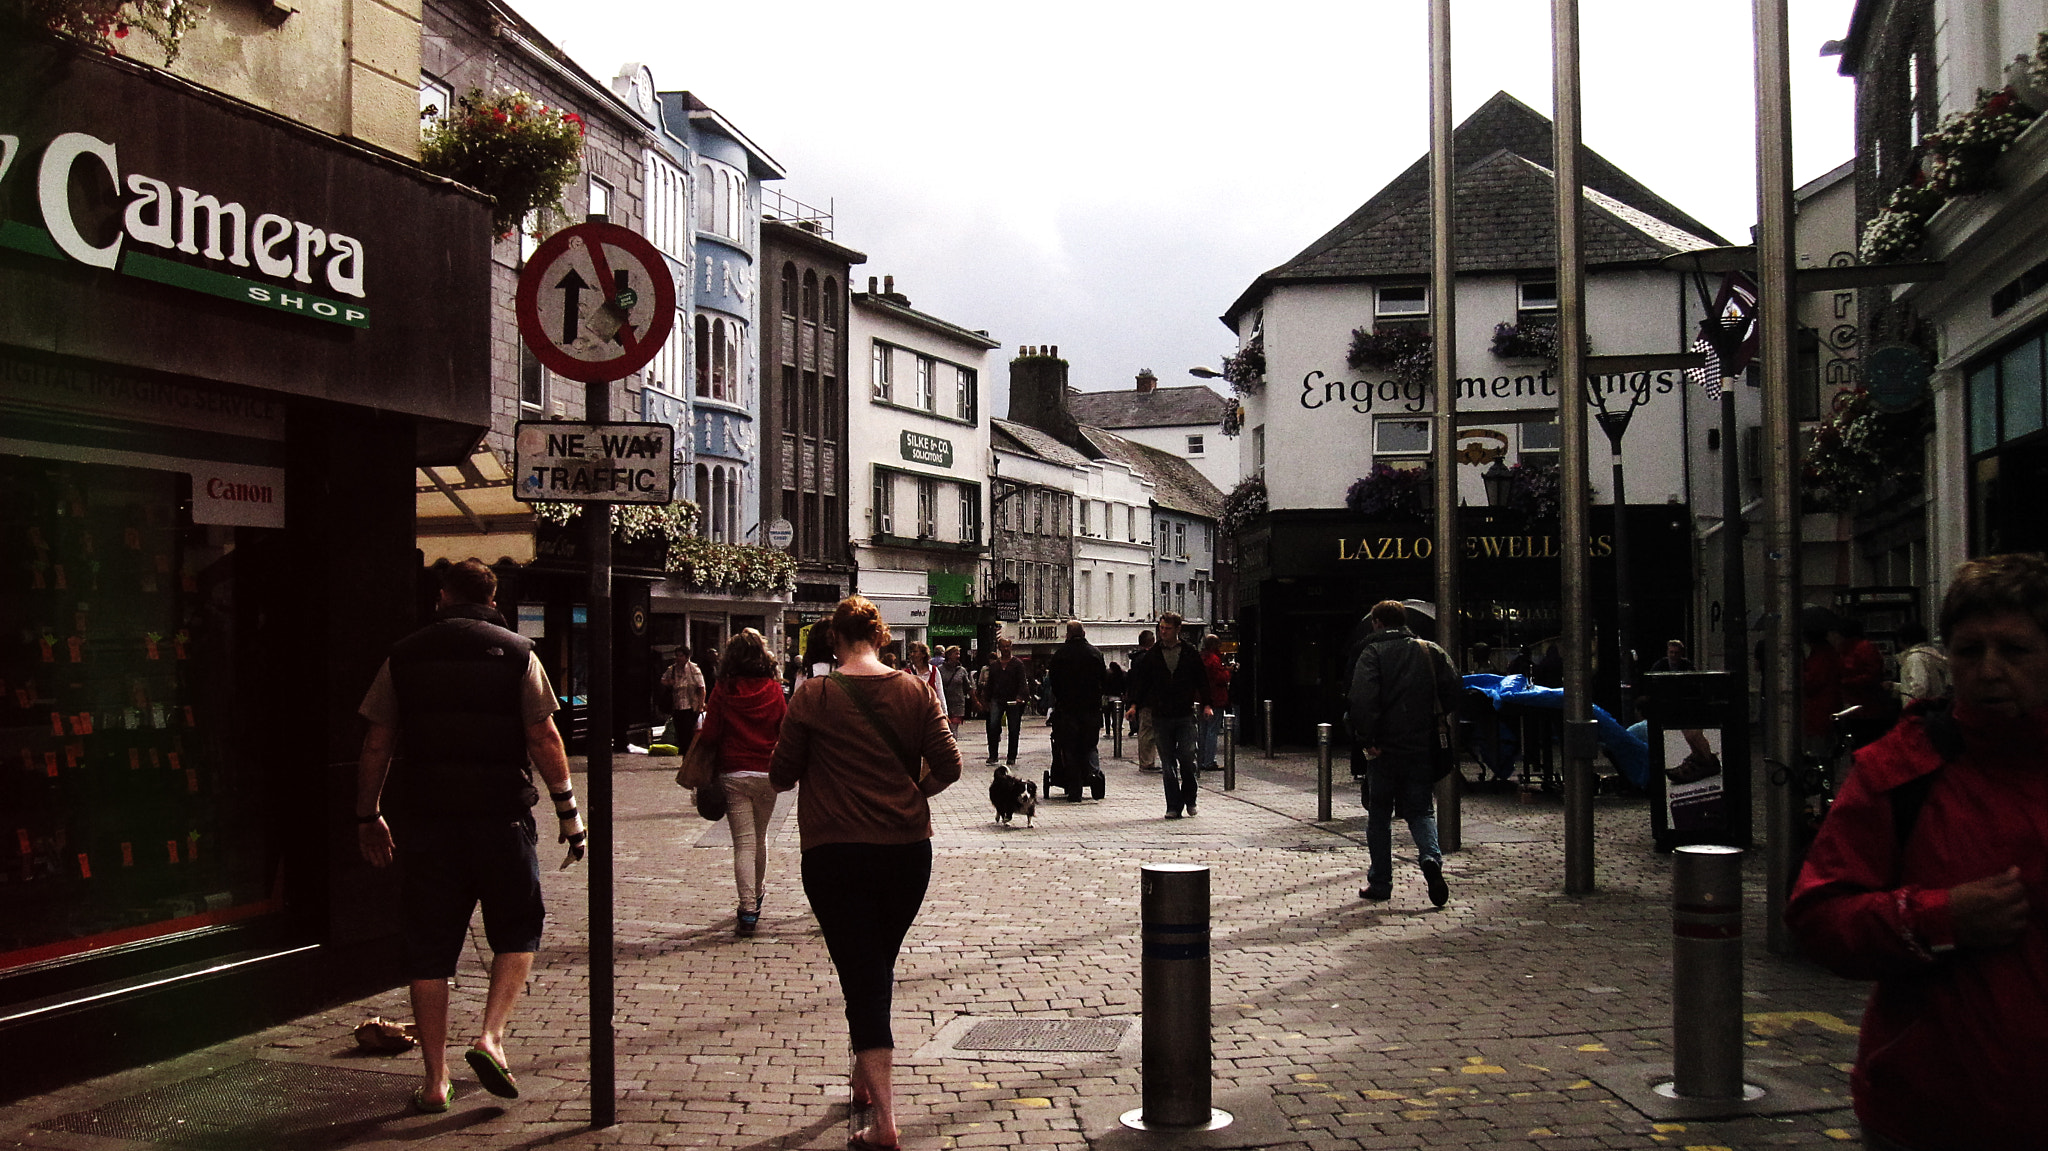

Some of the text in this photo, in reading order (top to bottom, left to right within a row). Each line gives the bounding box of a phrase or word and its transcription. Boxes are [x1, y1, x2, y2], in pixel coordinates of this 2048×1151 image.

[38, 132, 366, 298] Camera
[248, 286, 366, 321] SHOP
[92, 373, 191, 409] IMAGING
[197, 391, 274, 419] SERVICE
[1300, 369, 1673, 413] Engagment ings
[547, 434, 662, 459] NE WAY
[906, 433, 929, 450] SILKE
[206, 477, 273, 503] Canon
[532, 466, 656, 493] TRAFFIC
[1337, 537, 1433, 561] LAZLO
